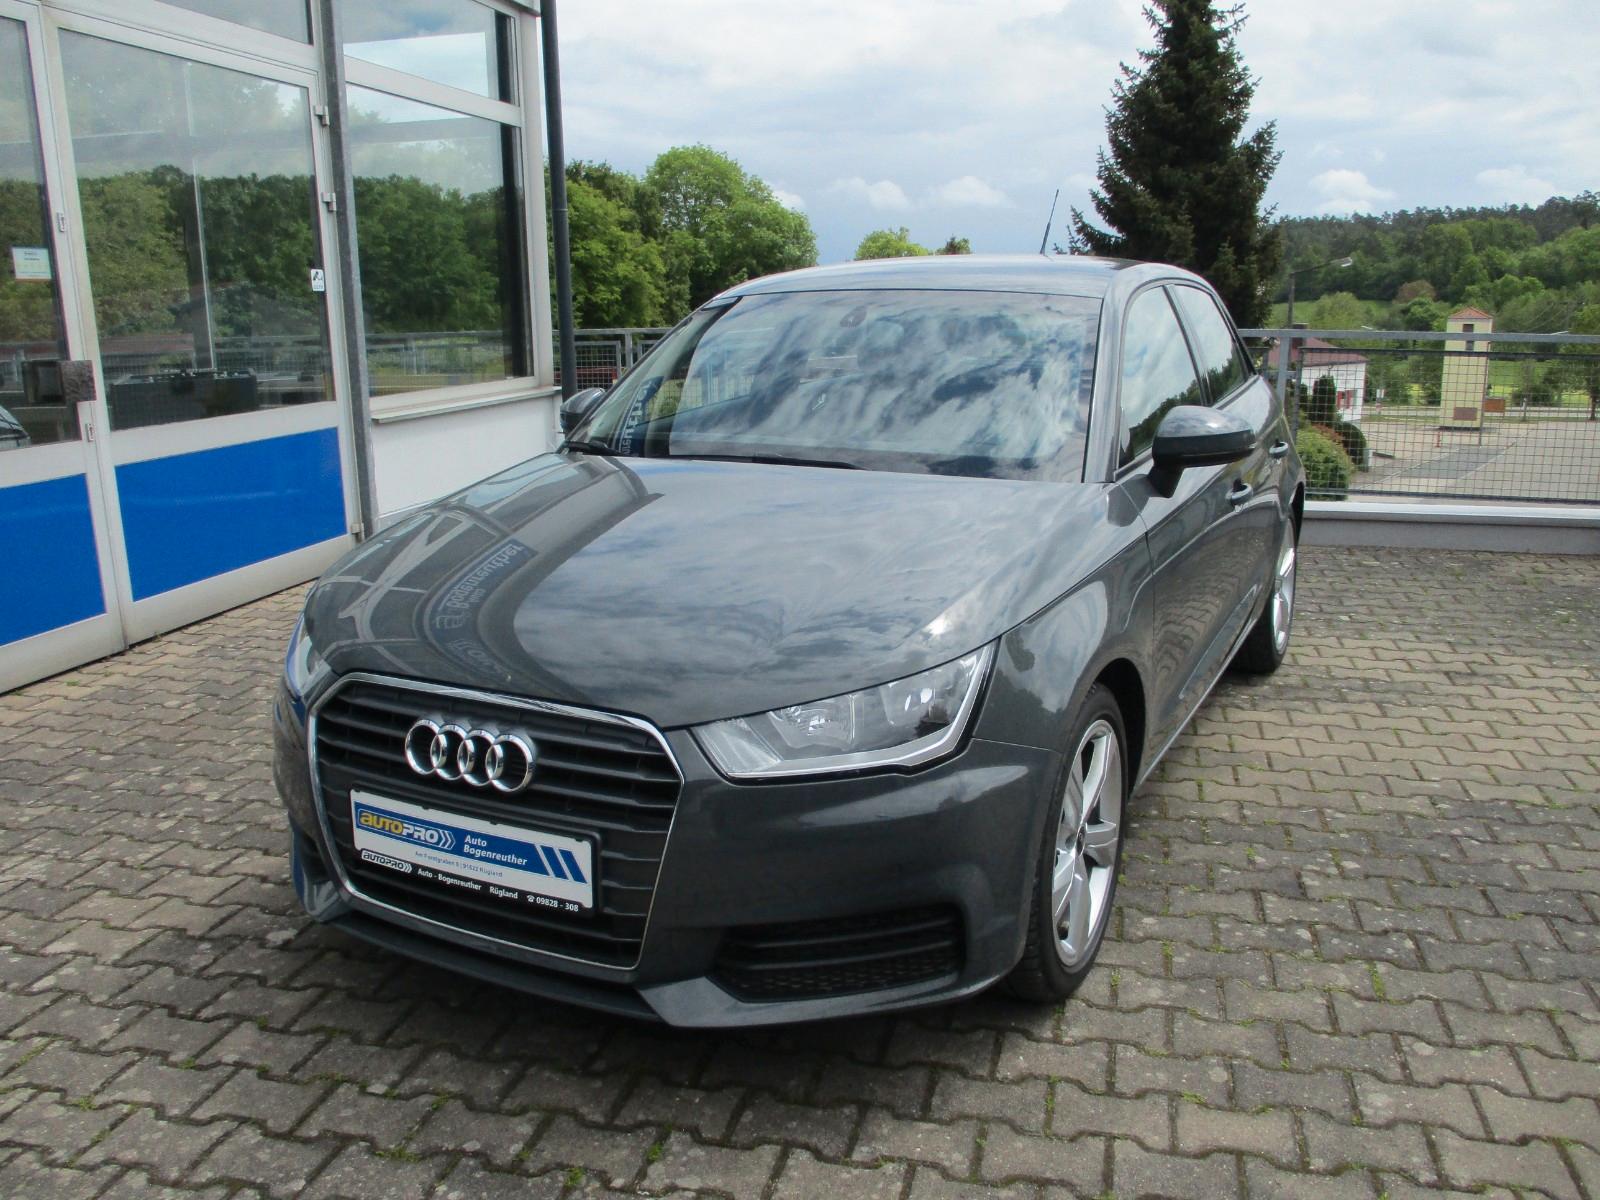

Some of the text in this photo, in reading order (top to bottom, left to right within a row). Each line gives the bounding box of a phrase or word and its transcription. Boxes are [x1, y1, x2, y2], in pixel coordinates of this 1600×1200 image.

[464, 834, 487, 847] Auto
[463, 844, 528, 866] Bogenreuther
[417, 868, 433, 879] Auto
[438, 873, 482, 891] Bogenreuther
[489, 886, 519, 900] Rügland
[536, 896, 558, 908] 09828
[565, 902, 579, 912] 308
